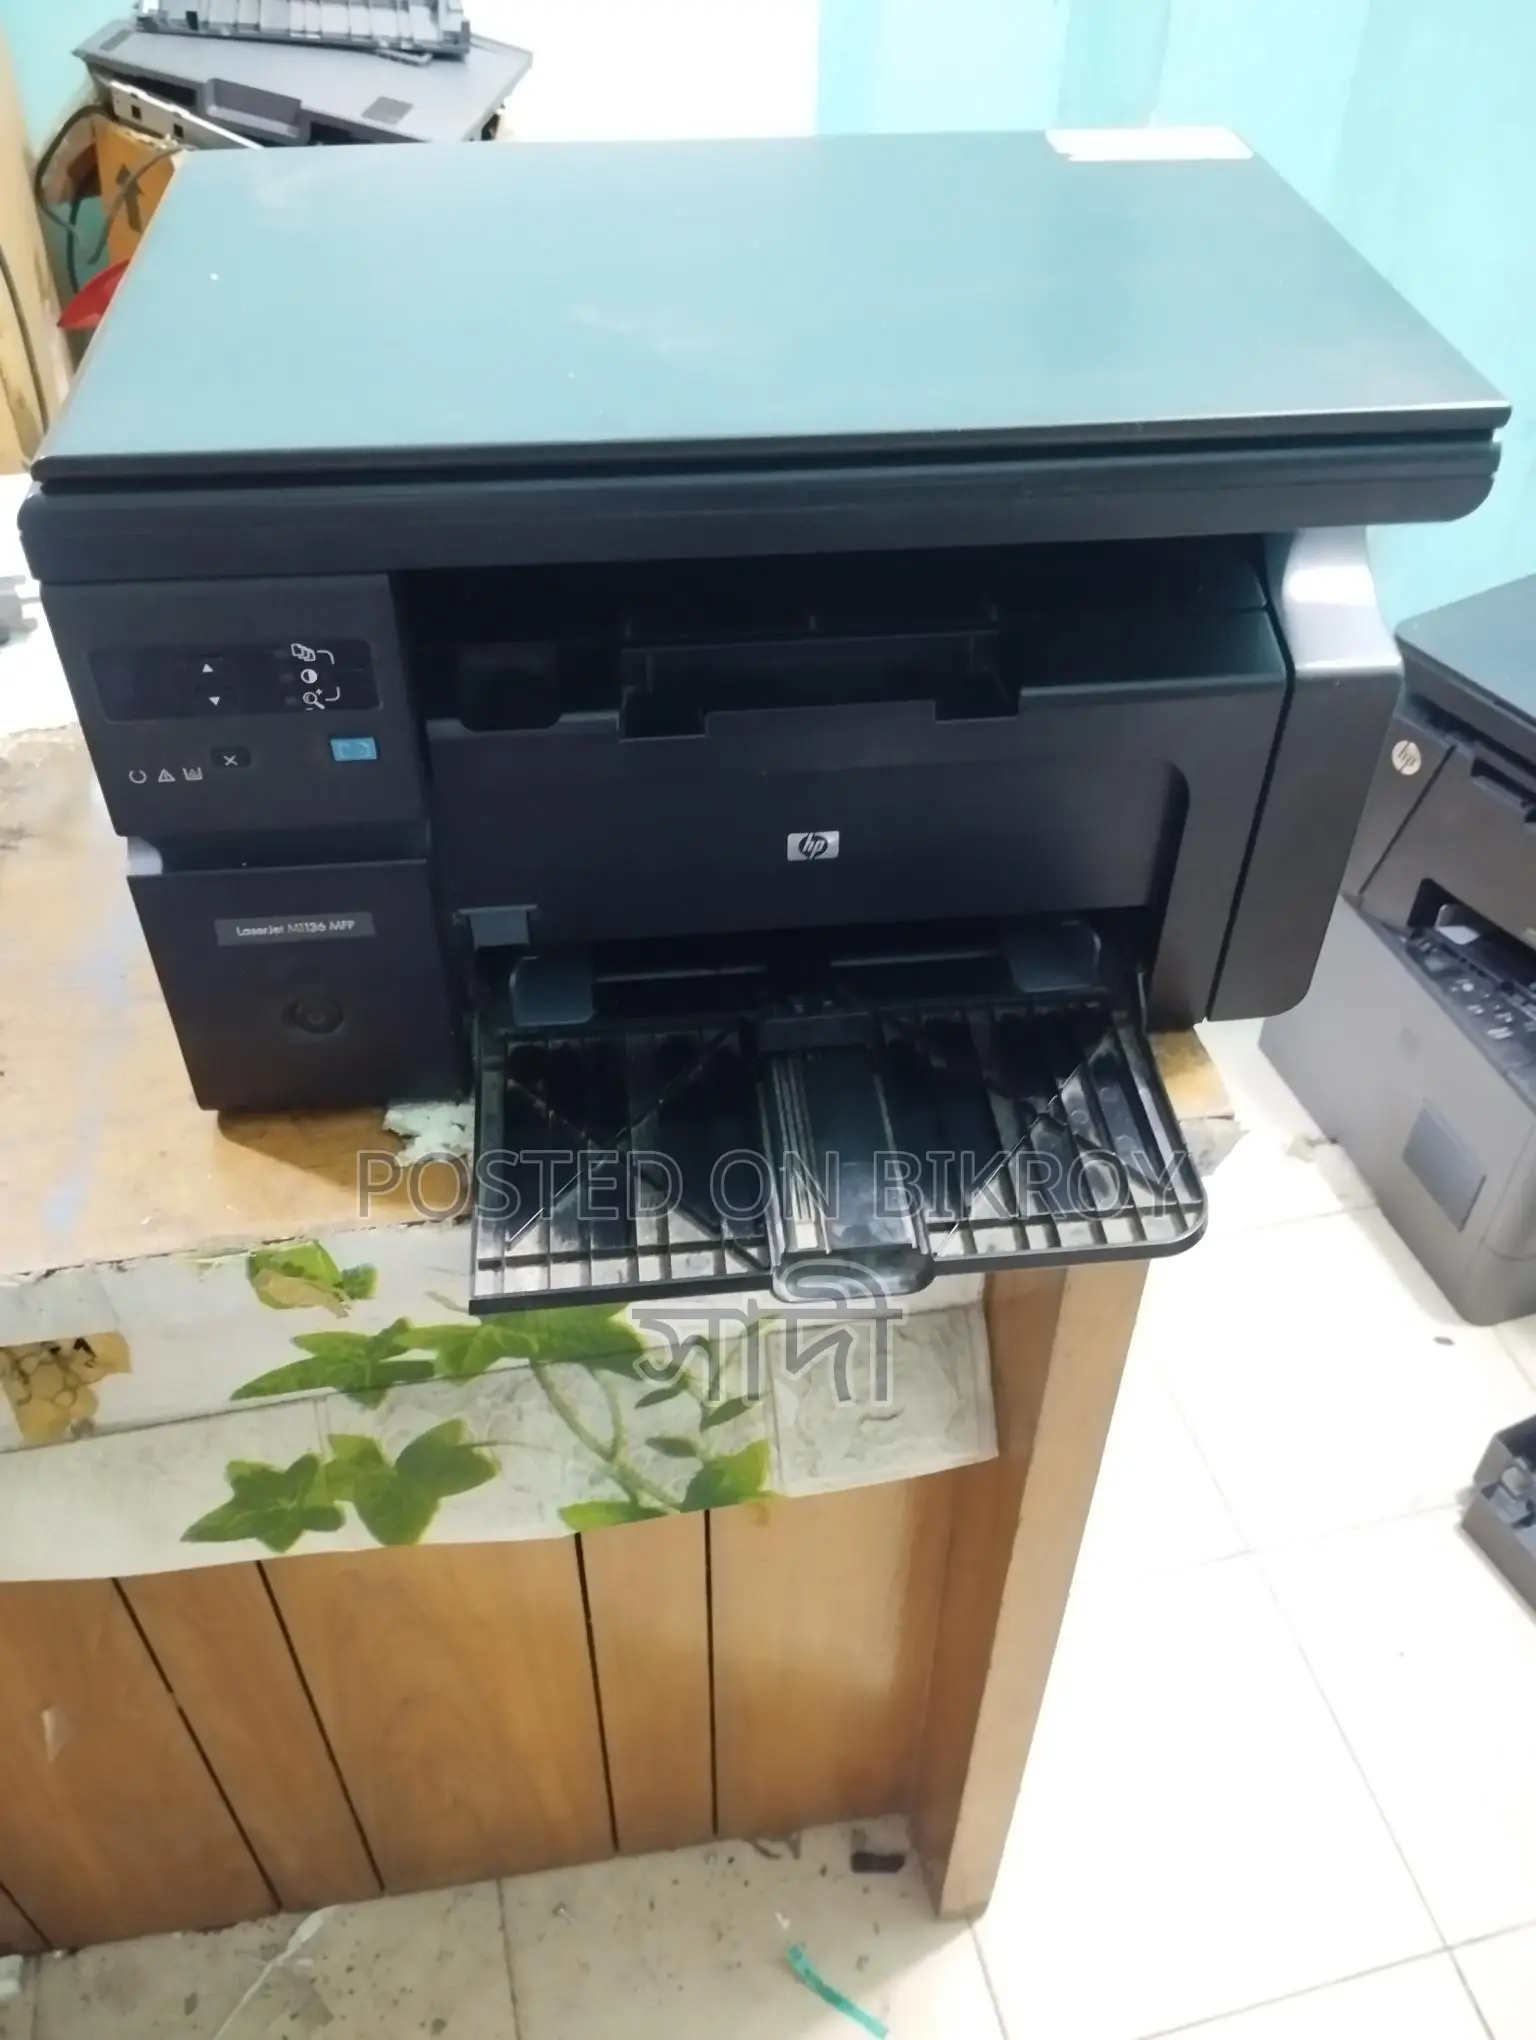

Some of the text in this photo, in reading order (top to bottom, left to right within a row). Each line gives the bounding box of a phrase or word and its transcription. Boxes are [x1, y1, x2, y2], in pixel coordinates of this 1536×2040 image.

[798, 832, 829, 860] hp
[287, 921, 327, 934] M1136
[329, 919, 355, 932] MFP
